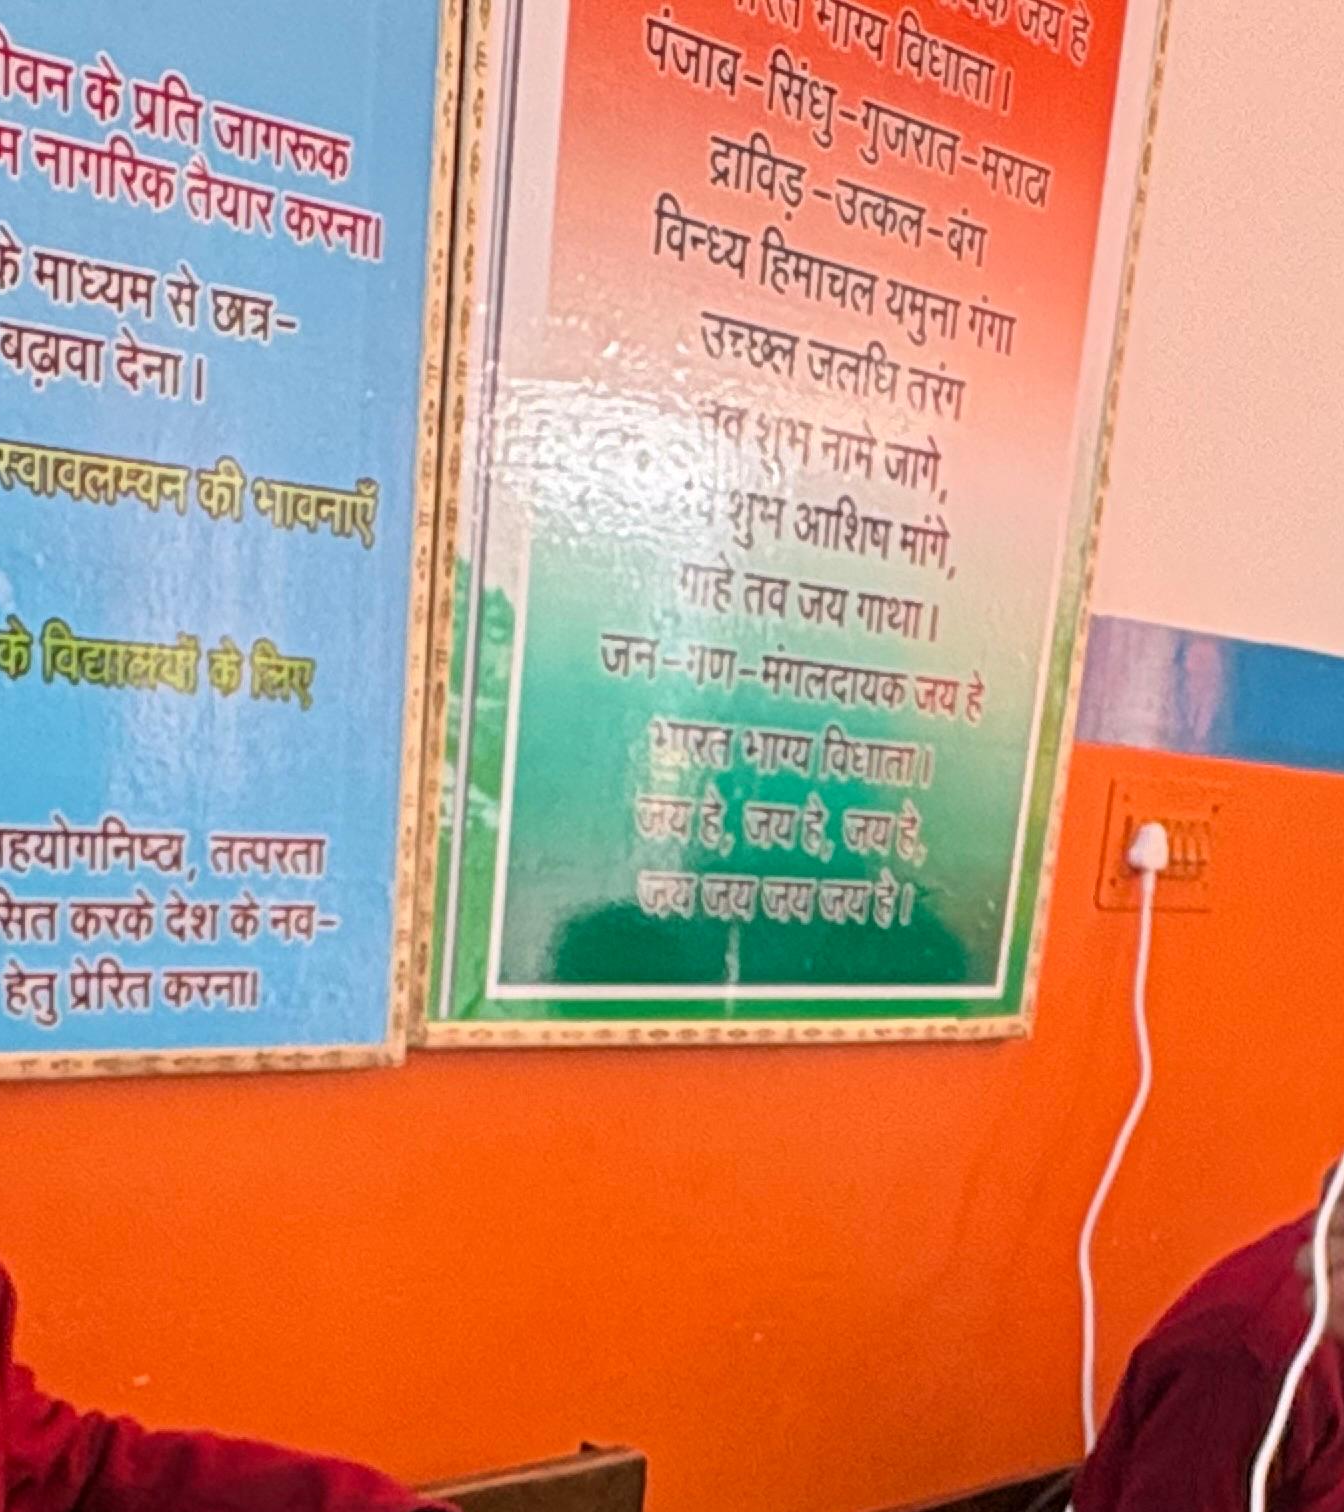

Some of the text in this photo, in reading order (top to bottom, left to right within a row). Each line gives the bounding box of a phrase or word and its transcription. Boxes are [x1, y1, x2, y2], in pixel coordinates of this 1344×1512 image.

[817, 0, 890, 61] भाग्य
[1018, 0, 1089, 62] जय हे
[86, 52, 121, 120] के
[134, 76, 202, 143] प्रति
[215, 105, 352, 180] जागरूक
[35, 131, 175, 207] नागरिक
[186, 155, 274, 231] तैयार
[35, 252, 156, 317] माध्यम
[167, 265, 199, 326] से
[654, 193, 1016, 355] विन्ध्य हिमाचल यमुना गंगा
[0, 322, 104, 388] बढ़ावा
[807, 340, 900, 403] जलधि
[908, 362, 966, 421] तरंग
[821, 419, 877, 479] नामे
[197, 456, 245, 522] की
[253, 477, 378, 549] भावनाएँ
[729, 489, 787, 549] शुभ
[795, 494, 892, 560] आशिष
[744, 572, 790, 618] तव
[798, 582, 849, 628] जय
[42, 617, 200, 694] विद्यालयों
[209, 635, 242, 696] के
[250, 638, 315, 710] लिए
[916, 676, 959, 716] जय
[966, 670, 984, 723] हे
[651, 720, 733, 769] भारत
[743, 730, 813, 776] भाग्य
[211, 836, 326, 875] तत्परता
[637, 797, 693, 840] जय
[746, 804, 799, 848] जय
[845, 812, 895, 854] जय
[70, 889, 154, 941] करके
[165, 889, 219, 942] देश
[230, 890, 259, 941] के
[638, 874, 696, 917] जय
[703, 876, 757, 921] जय
[763, 878, 816, 922] जय
[820, 881, 871, 924] जय
[4, 959, 57, 1025] हेतु
[70, 957, 153, 1009] प्रेरित
